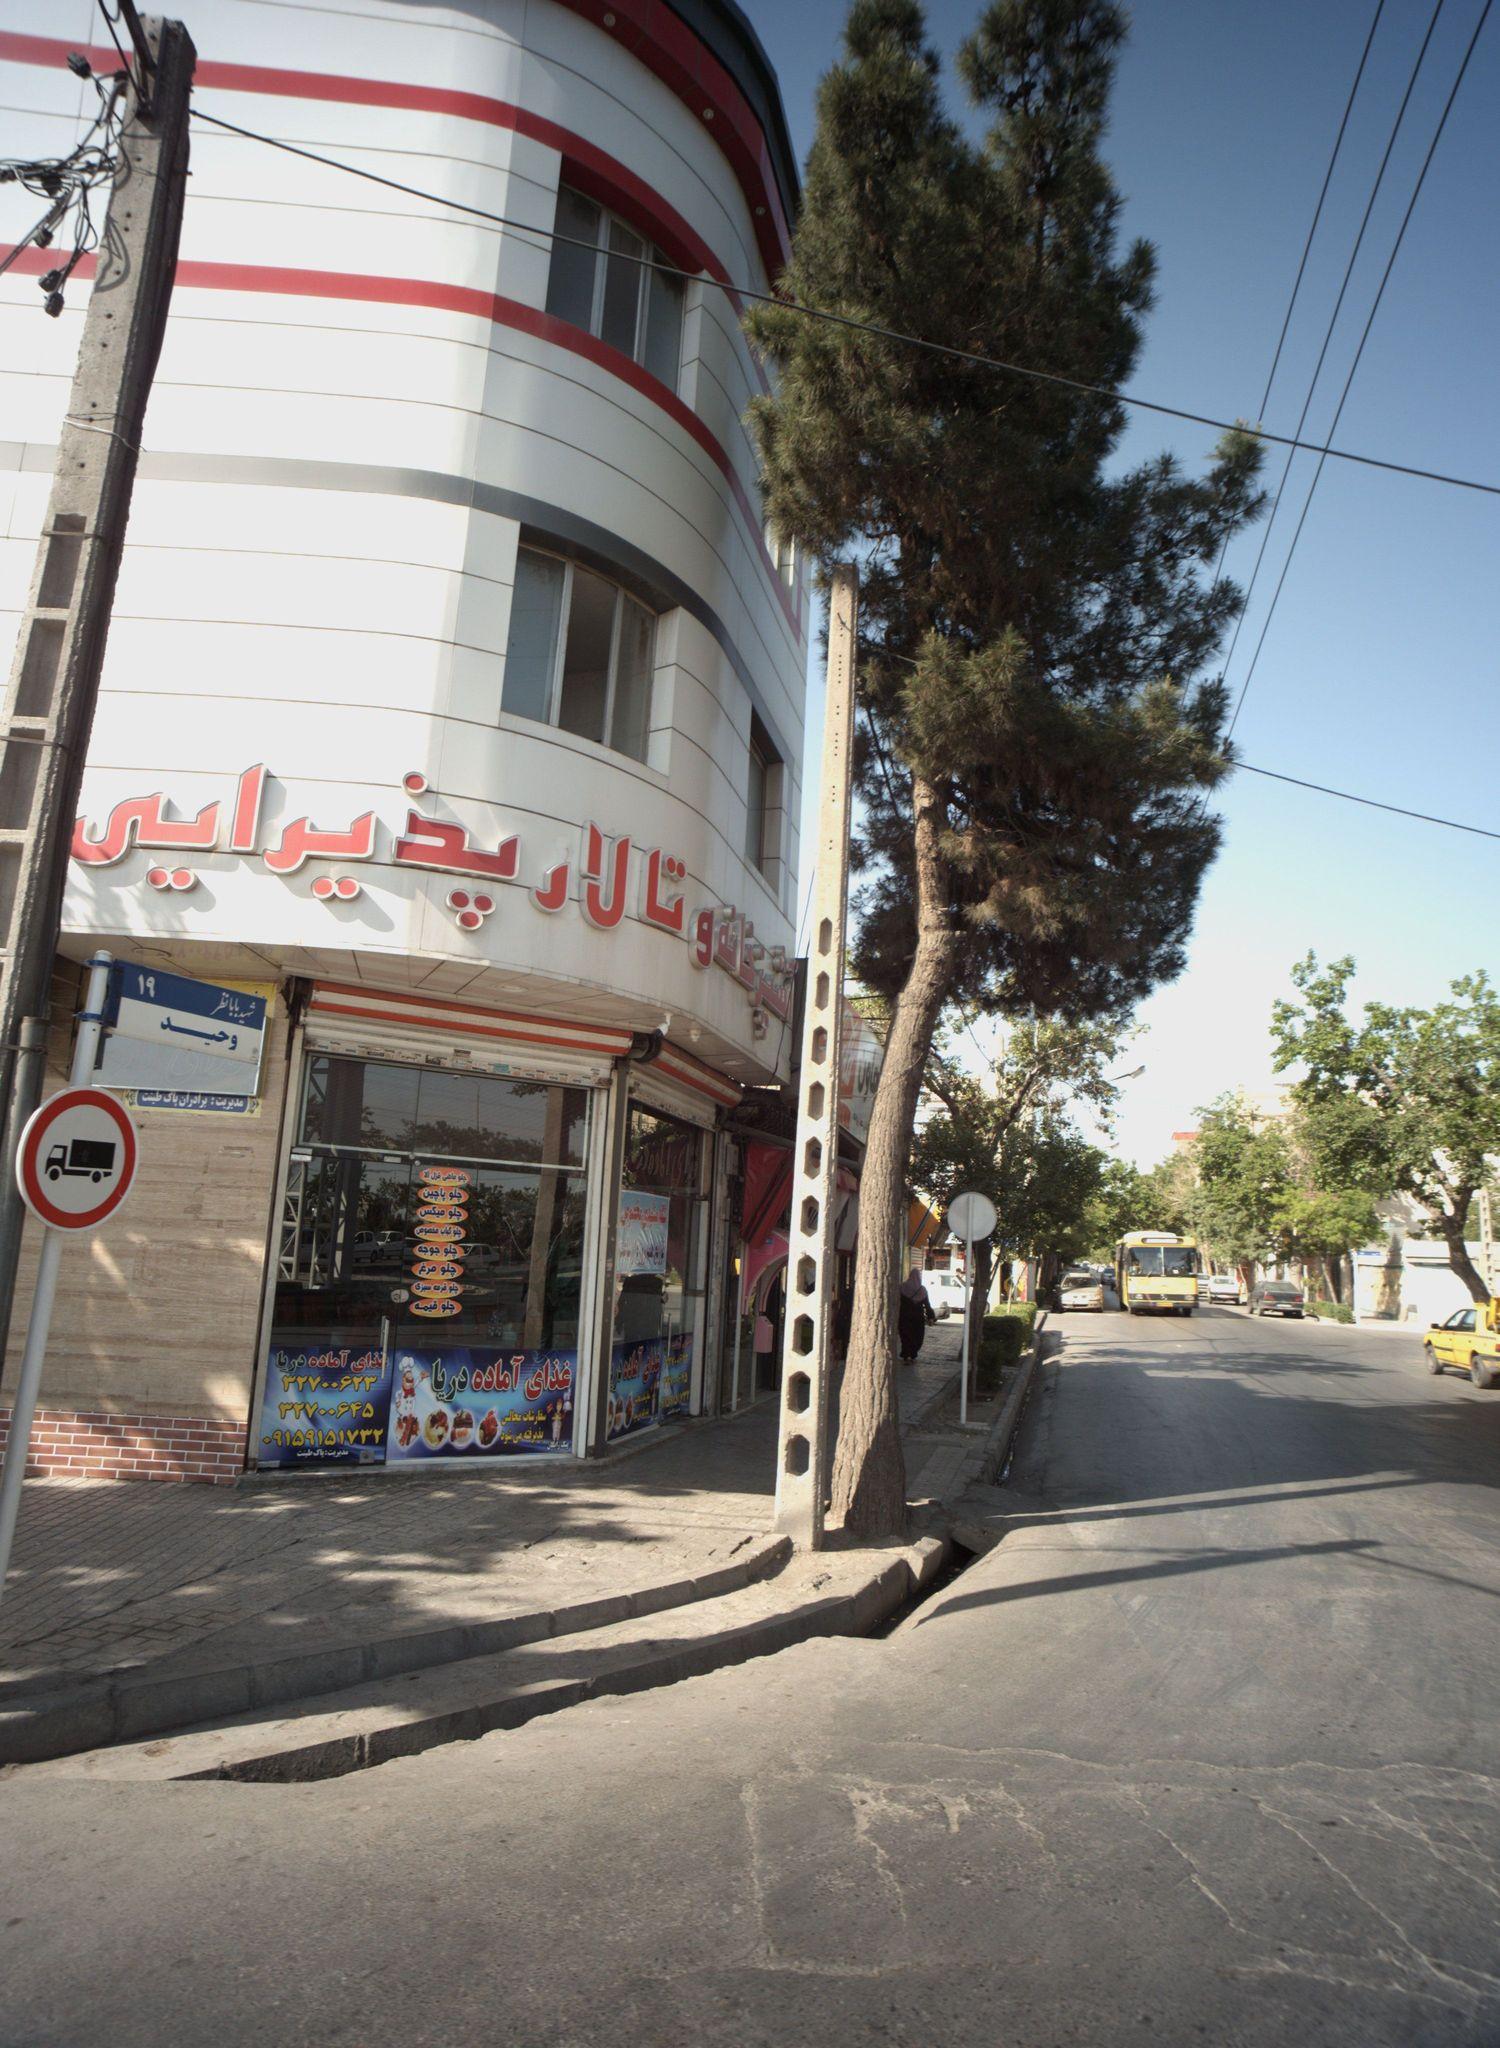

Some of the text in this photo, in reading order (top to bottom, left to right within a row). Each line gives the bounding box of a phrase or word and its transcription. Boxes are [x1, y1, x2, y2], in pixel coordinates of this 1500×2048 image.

[71, 763, 521, 931] پذیرایی
[529, 820, 687, 931] تالار
[138, 973, 156, 998] ۱۹
[160, 1016, 238, 1050] وحید
[162, 1092, 180, 1107] پاک
[448, 1191, 463, 1203] چلو
[419, 1206, 463, 1220] چلو میکس
[452, 1227, 462, 1239] چلو
[417, 1244, 458, 1259] چلو جوجه
[418, 1263, 457, 1278] چلو مرغ
[414, 1282, 432, 1293] سبزی
[448, 1283, 459, 1295] چلو
[414, 1300, 456, 1315] چلو قیمه
[275, 1350, 306, 1373] دریا
[307, 1349, 351, 1369] آماده
[430, 1358, 470, 1402] دریا
[472, 1354, 525, 1393] آماده
[524, 1358, 573, 1401] غذای
[278, 1401, 375, 1420] ۳۲۷۰۰۶۴۵
[262, 1428, 384, 1447] ۰۹۱۵۹۱۵۱۷۳۲
